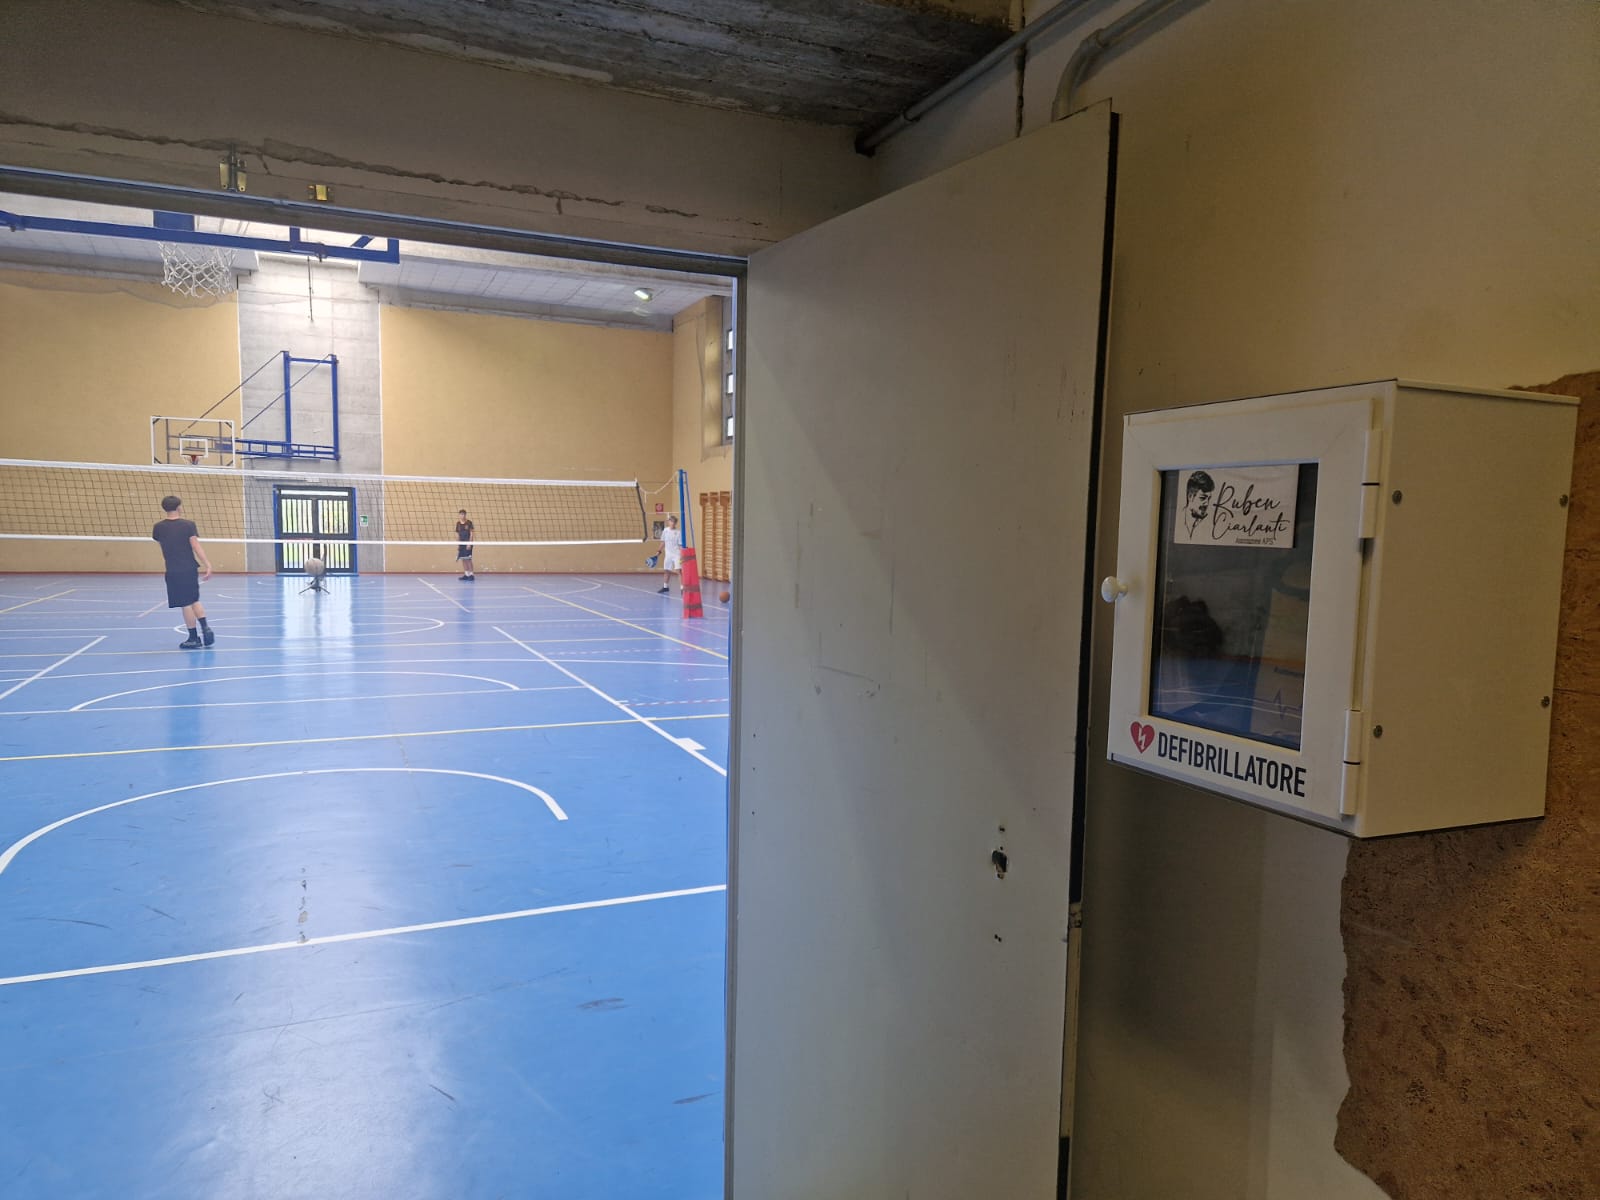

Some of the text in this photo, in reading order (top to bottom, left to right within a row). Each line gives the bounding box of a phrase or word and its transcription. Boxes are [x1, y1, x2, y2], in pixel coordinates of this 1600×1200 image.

[1213, 482, 1280, 524] Ruben
[1212, 511, 1290, 541] Ciarlanti
[1158, 732, 1307, 798] DEFIBRILLATORE
